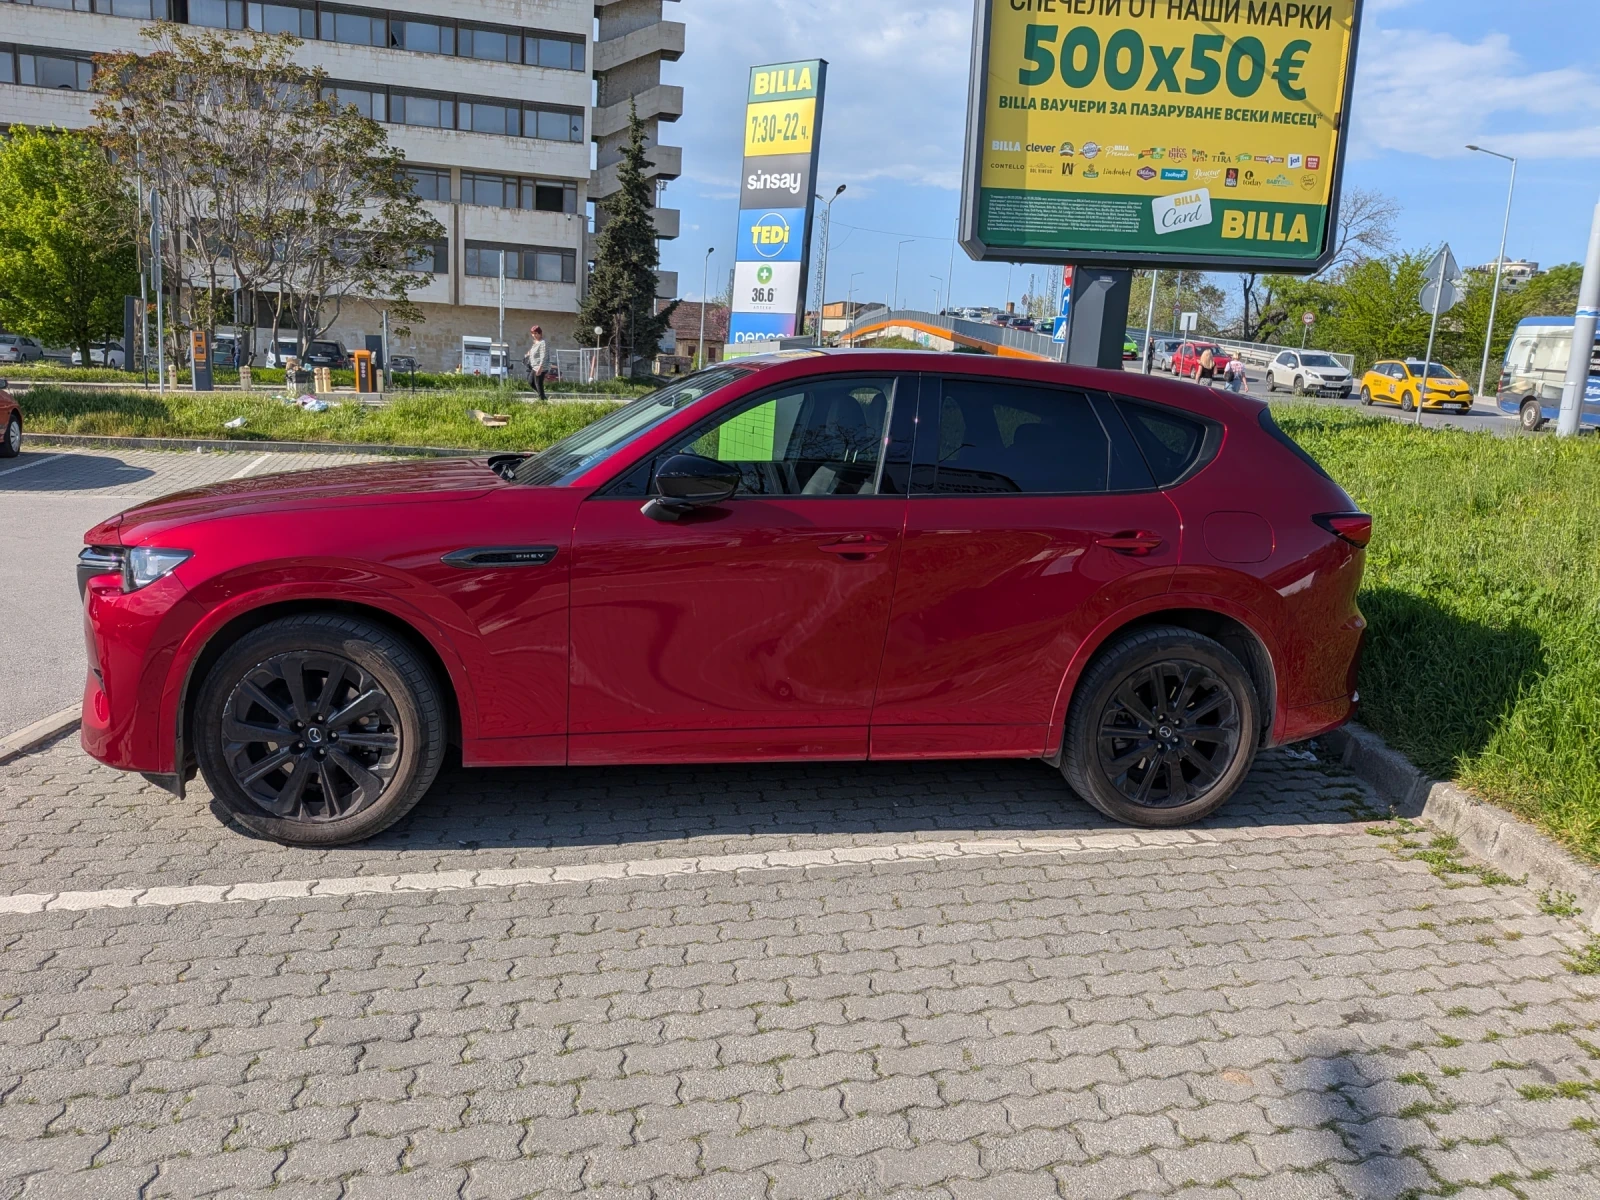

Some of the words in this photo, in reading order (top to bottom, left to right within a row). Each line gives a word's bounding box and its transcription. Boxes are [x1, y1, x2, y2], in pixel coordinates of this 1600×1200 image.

[1166, 0, 1241, 24] НАШИ
[1246, 1, 1333, 30] МАРКИ
[753, 67, 812, 96] BILLA
[999, 95, 1037, 111] BILLA
[1040, 98, 1106, 114] ВАУЧЕРИ
[1109, 101, 1127, 115] ЗА
[1130, 103, 1223, 121] ПАЗАРУВАНЕ
[1224, 106, 1269, 123] ВСЕКИ
[751, 112, 798, 144] 7:30-22
[992, 140, 1021, 152] BILLA
[1025, 143, 1056, 153] clever
[1168, 151, 1187, 160] bites
[1212, 155, 1232, 164] TIRA
[747, 169, 801, 194] sinsay
[1242, 178, 1263, 188] today
[1173, 193, 1201, 207] BILLA
[1161, 204, 1203, 228] Card
[1220, 209, 1309, 243] BILLA
[750, 225, 790, 245] TEDi
